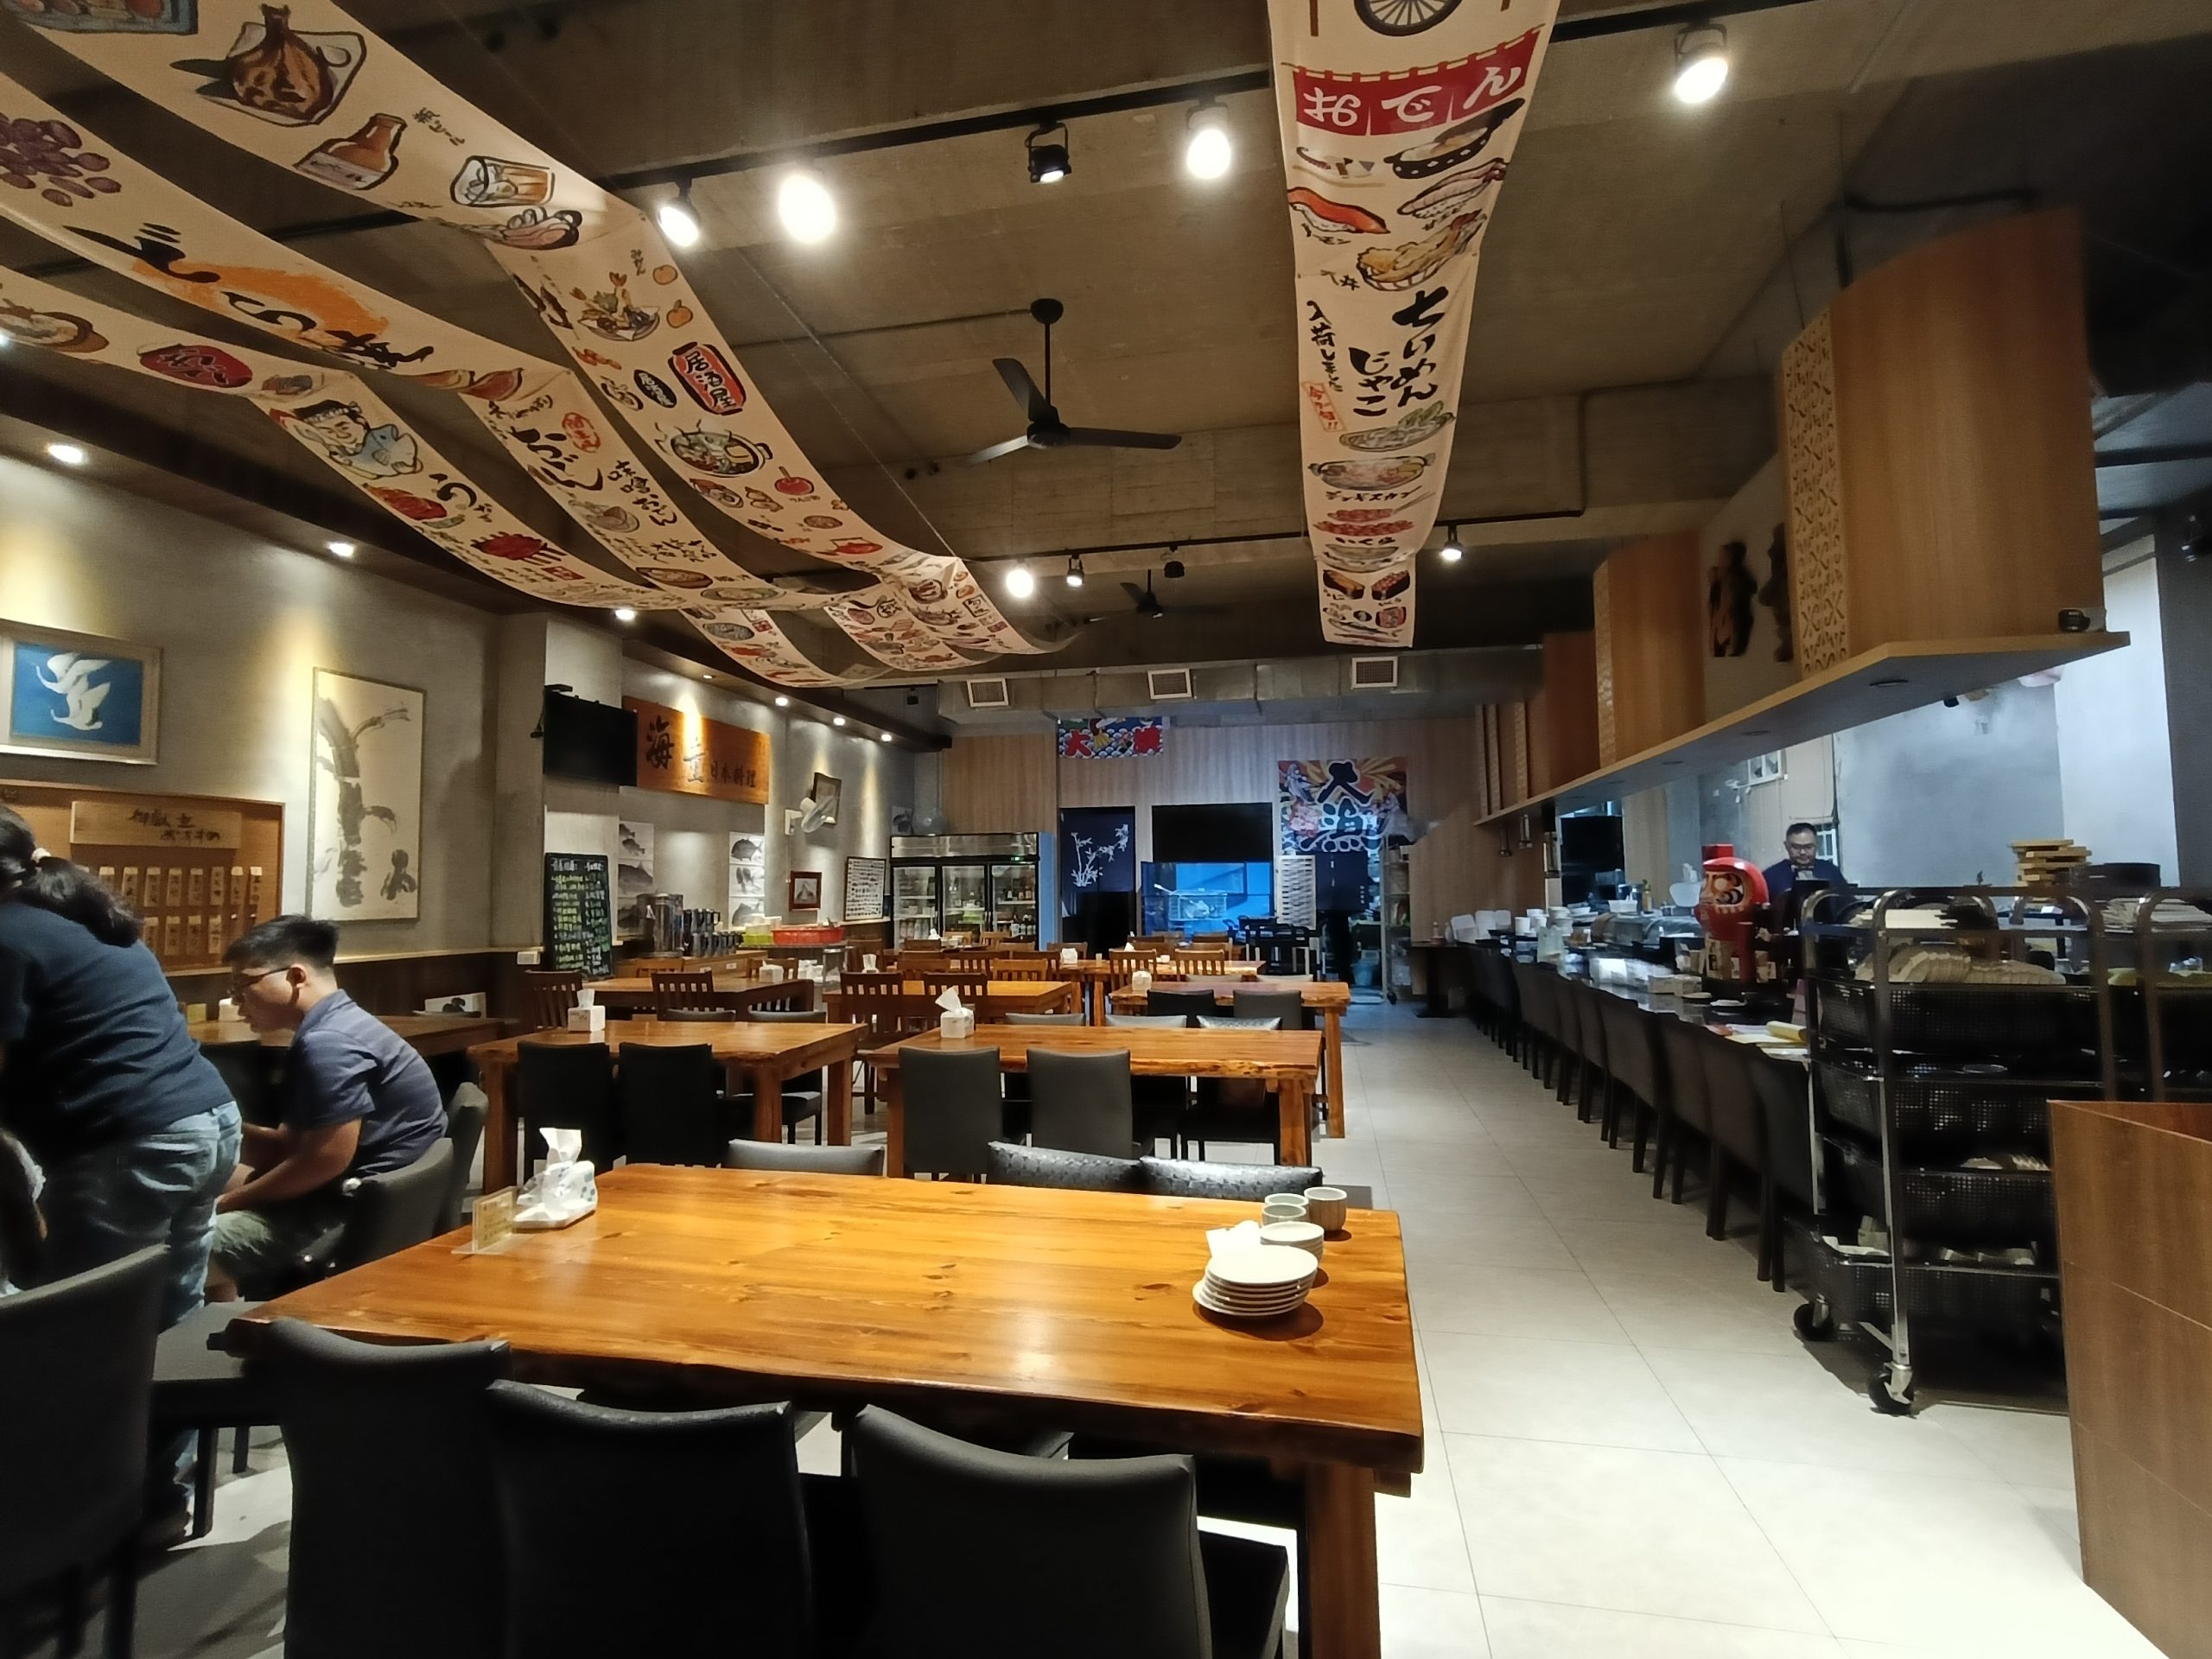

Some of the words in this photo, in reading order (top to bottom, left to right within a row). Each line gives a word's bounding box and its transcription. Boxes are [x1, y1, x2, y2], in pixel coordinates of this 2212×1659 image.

[1303, 67, 1522, 127] おでん
[685, 351, 736, 408] 居酒屋
[710, 760, 757, 788] 日本料理
